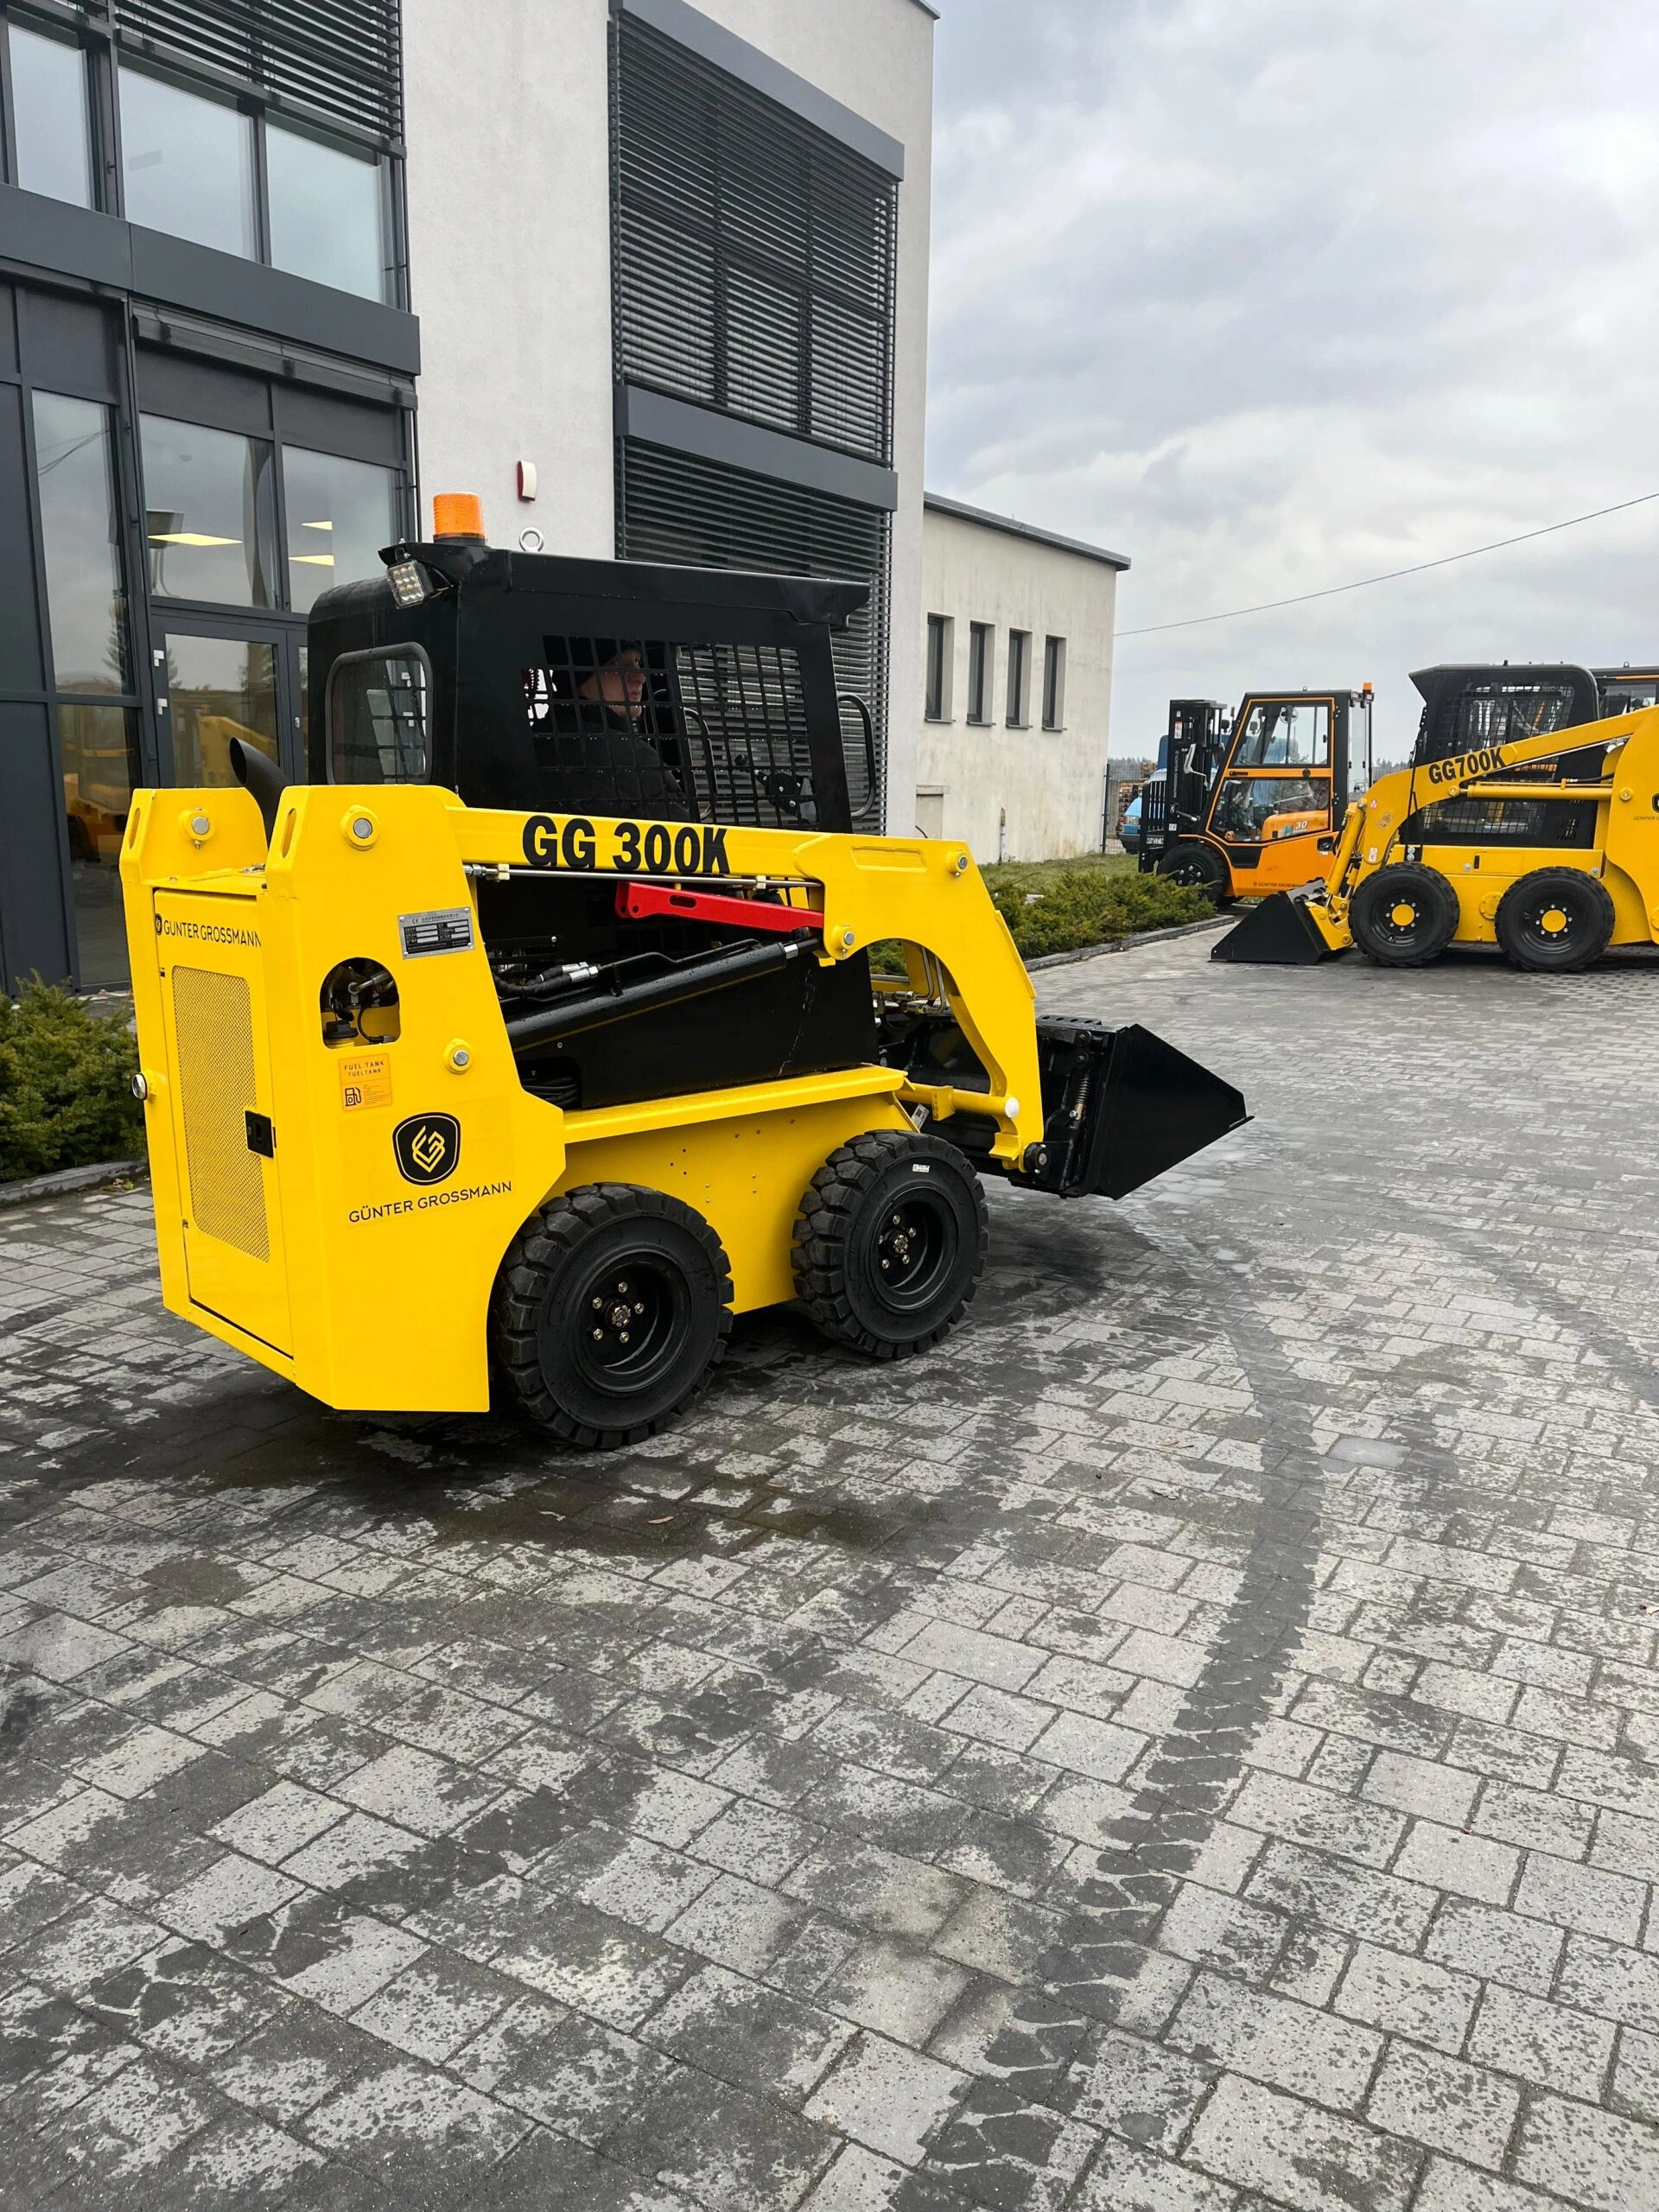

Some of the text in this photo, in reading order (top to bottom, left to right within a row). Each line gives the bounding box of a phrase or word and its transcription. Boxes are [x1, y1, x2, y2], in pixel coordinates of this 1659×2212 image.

[1428, 747, 1507, 785] GG700K
[522, 815, 731, 874] GG 300K
[200, 925, 262, 947] GROSSMANN
[348, 1180, 512, 1224] GÜNTER GROSSMANN
